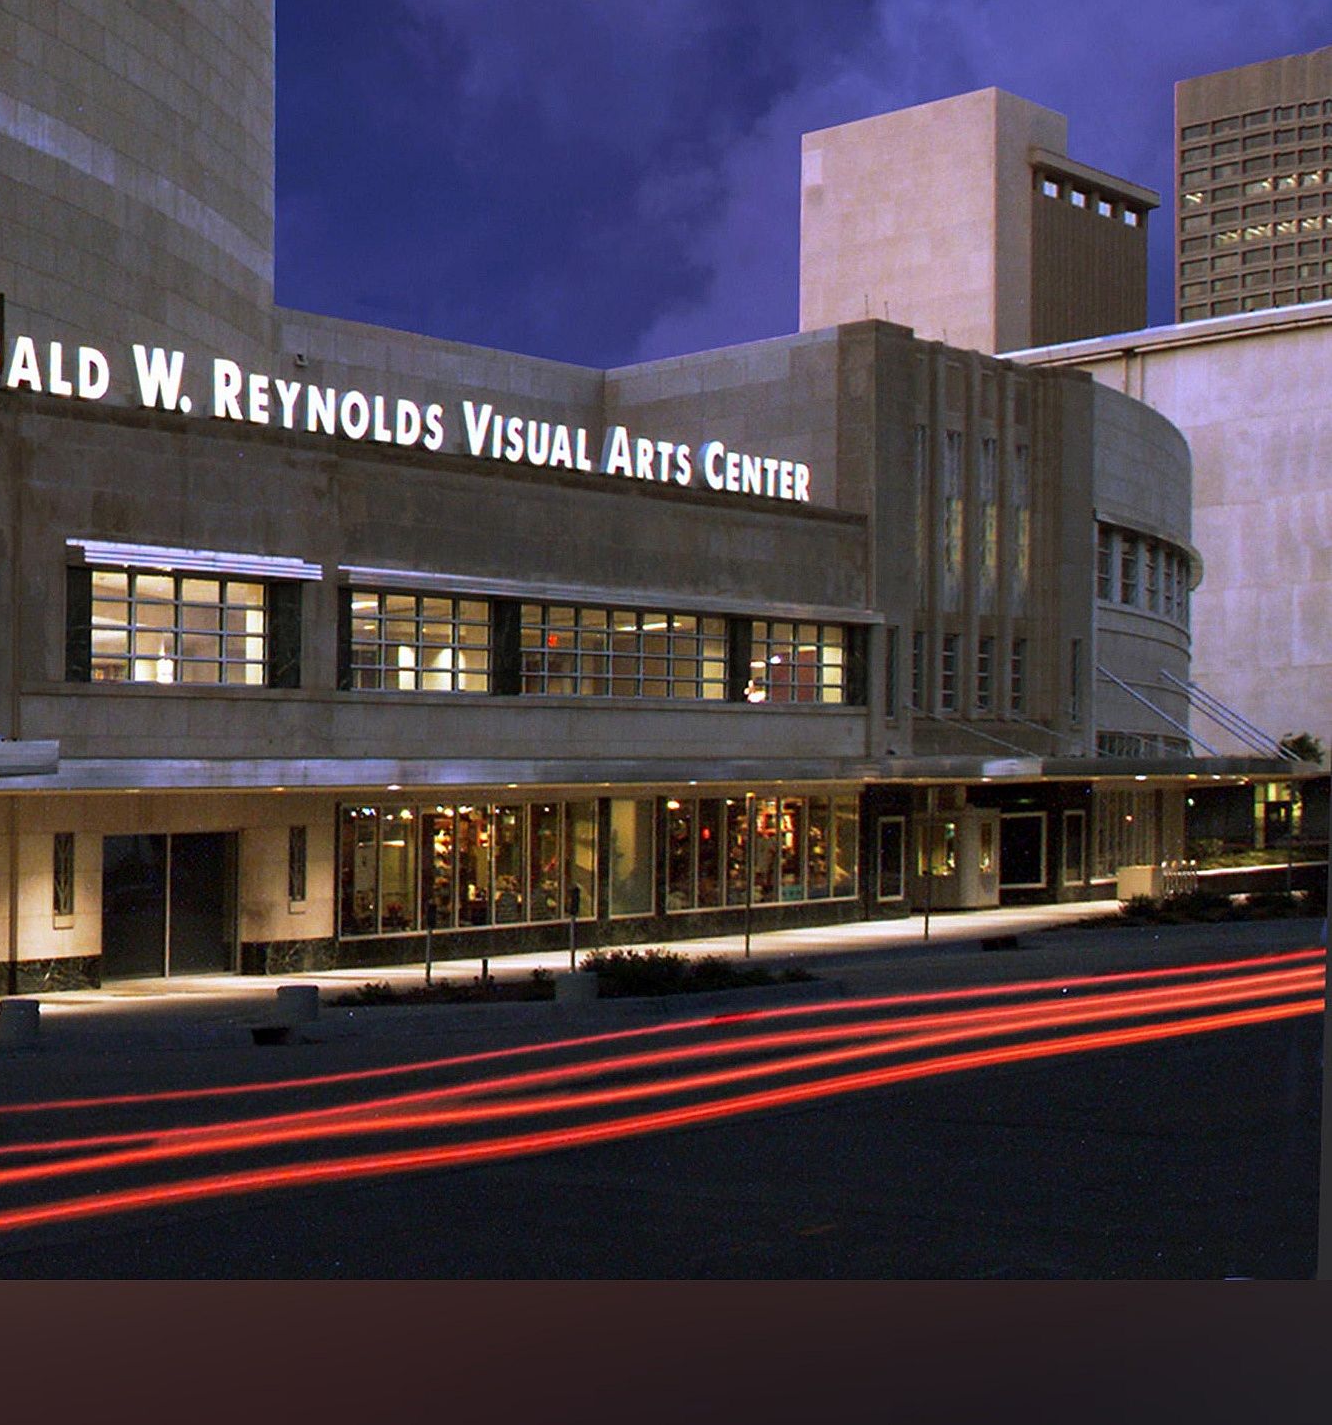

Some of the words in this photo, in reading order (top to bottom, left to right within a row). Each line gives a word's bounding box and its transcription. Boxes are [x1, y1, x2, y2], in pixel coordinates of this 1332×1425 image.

[131, 343, 193, 414] W.
[213, 357, 444, 451] REYNOLDS
[462, 400, 592, 472] VISUAL
[604, 425, 692, 486] ARTS
[701, 440, 810, 502] CENTER
